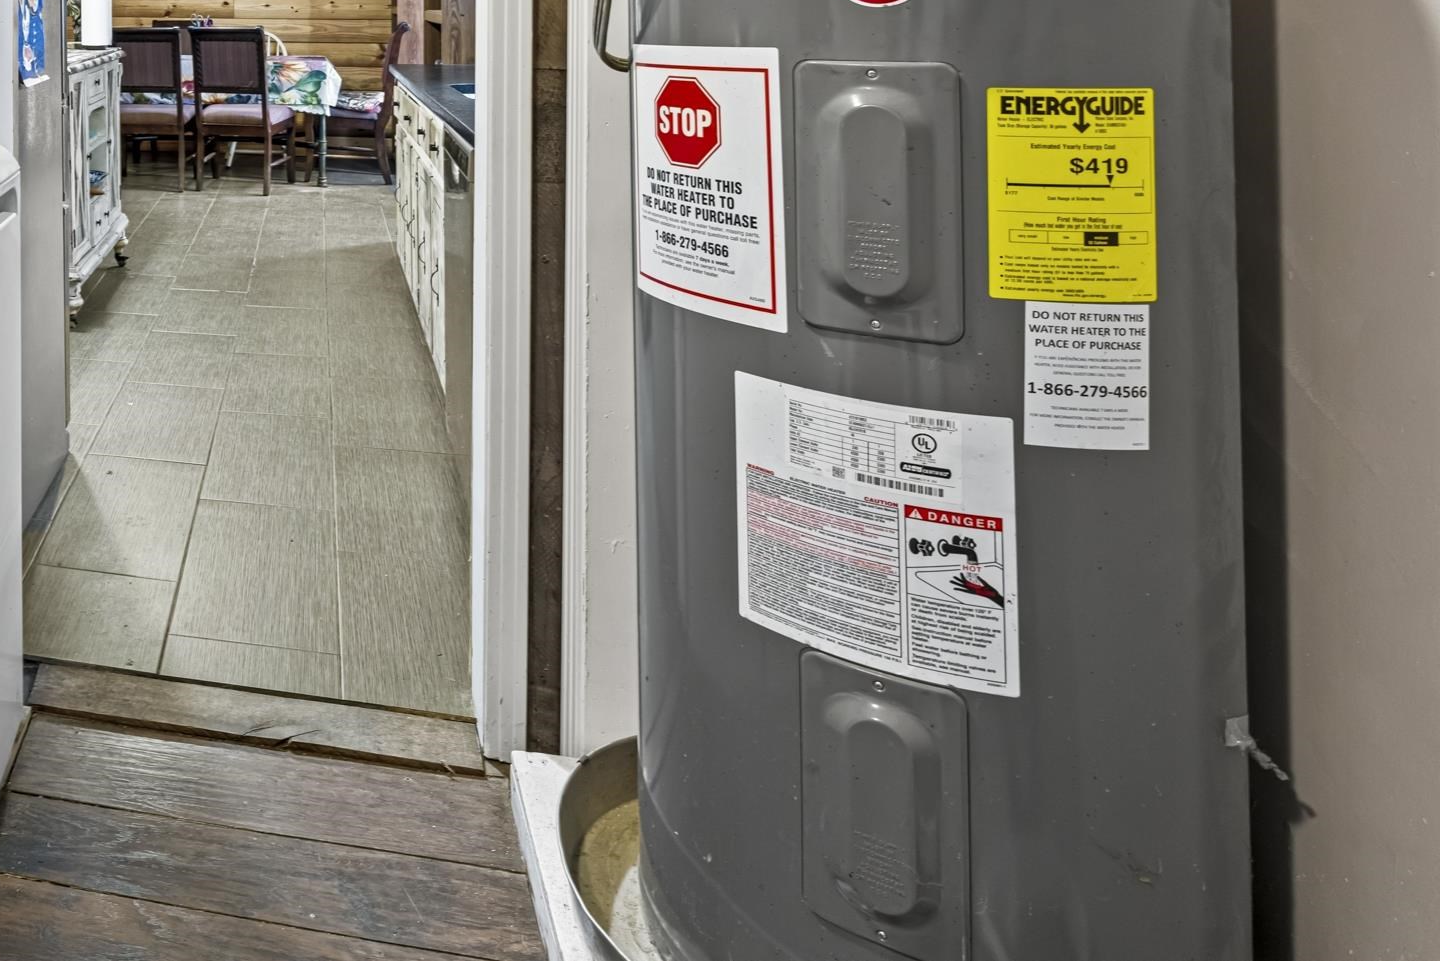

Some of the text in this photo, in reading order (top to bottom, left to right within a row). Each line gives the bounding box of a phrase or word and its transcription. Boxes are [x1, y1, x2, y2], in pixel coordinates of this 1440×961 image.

[1000, 96, 1145, 116] ENERGYGUIDE
[659, 105, 712, 138] STOP
[1063, 143, 1081, 151] Yearly
[1083, 143, 1102, 151] Energy
[1069, 157, 1128, 175] $419
[647, 167, 742, 195] DO NOT RETURN THIS
[650, 183, 735, 210] WATER HEATER TO
[642, 194, 653, 208] THE
[654, 197, 677, 215] PLACE
[680, 204, 692, 218] OF
[695, 208, 758, 230] PURCHASE
[655, 229, 729, 258] 1-866-279-4566
[1032, 310, 1144, 323] DO NOT RETURN THIS
[1028, 324, 1146, 337] WATER HEATER TO THE
[1035, 338, 1142, 351] PLACE OF PURCHASE
[1027, 381, 1147, 399] 1-866-279-4566
[747, 463, 774, 476] WARNING
[863, 496, 898, 508] CAUTION
[927, 511, 997, 529] DANGER
[962, 564, 982, 573] HOT
